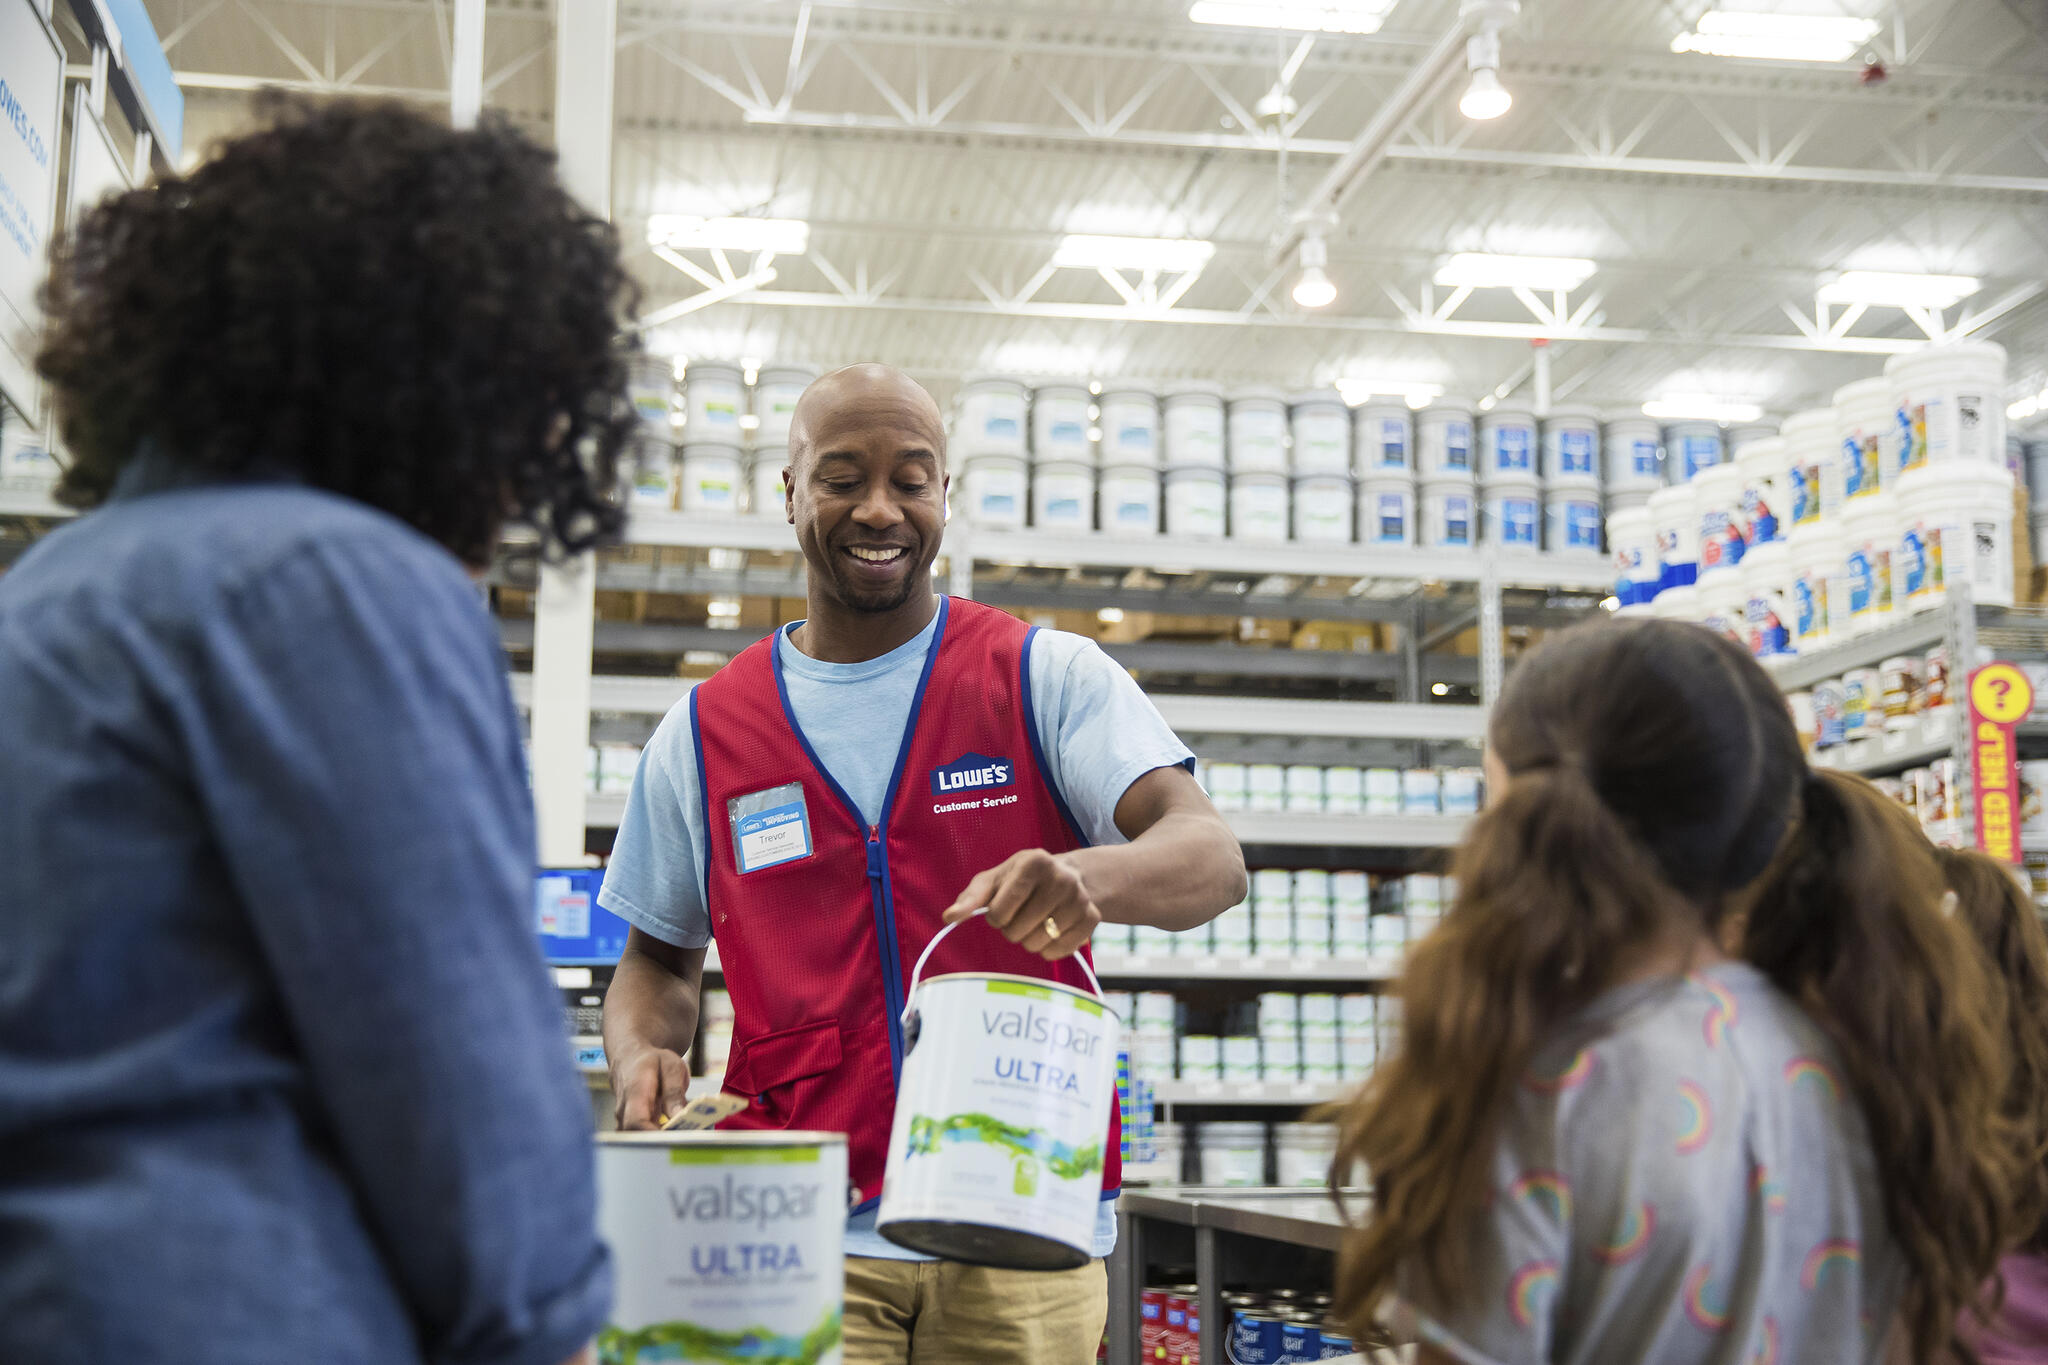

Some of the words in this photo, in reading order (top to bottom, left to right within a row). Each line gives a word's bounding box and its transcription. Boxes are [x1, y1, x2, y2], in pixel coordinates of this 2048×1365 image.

[1977, 721, 2008, 789] HELP
[938, 764, 1008, 791] LOWE'S
[933, 800, 981, 814] Customer
[983, 794, 1018, 808] Service
[759, 831, 786, 845] Trevor
[1982, 791, 2013, 860] NEED
[982, 1003, 1102, 1057] valspar
[994, 1055, 1080, 1094] ULTRA
[668, 1172, 822, 1232] valspar
[690, 1243, 804, 1276] ULTRA
